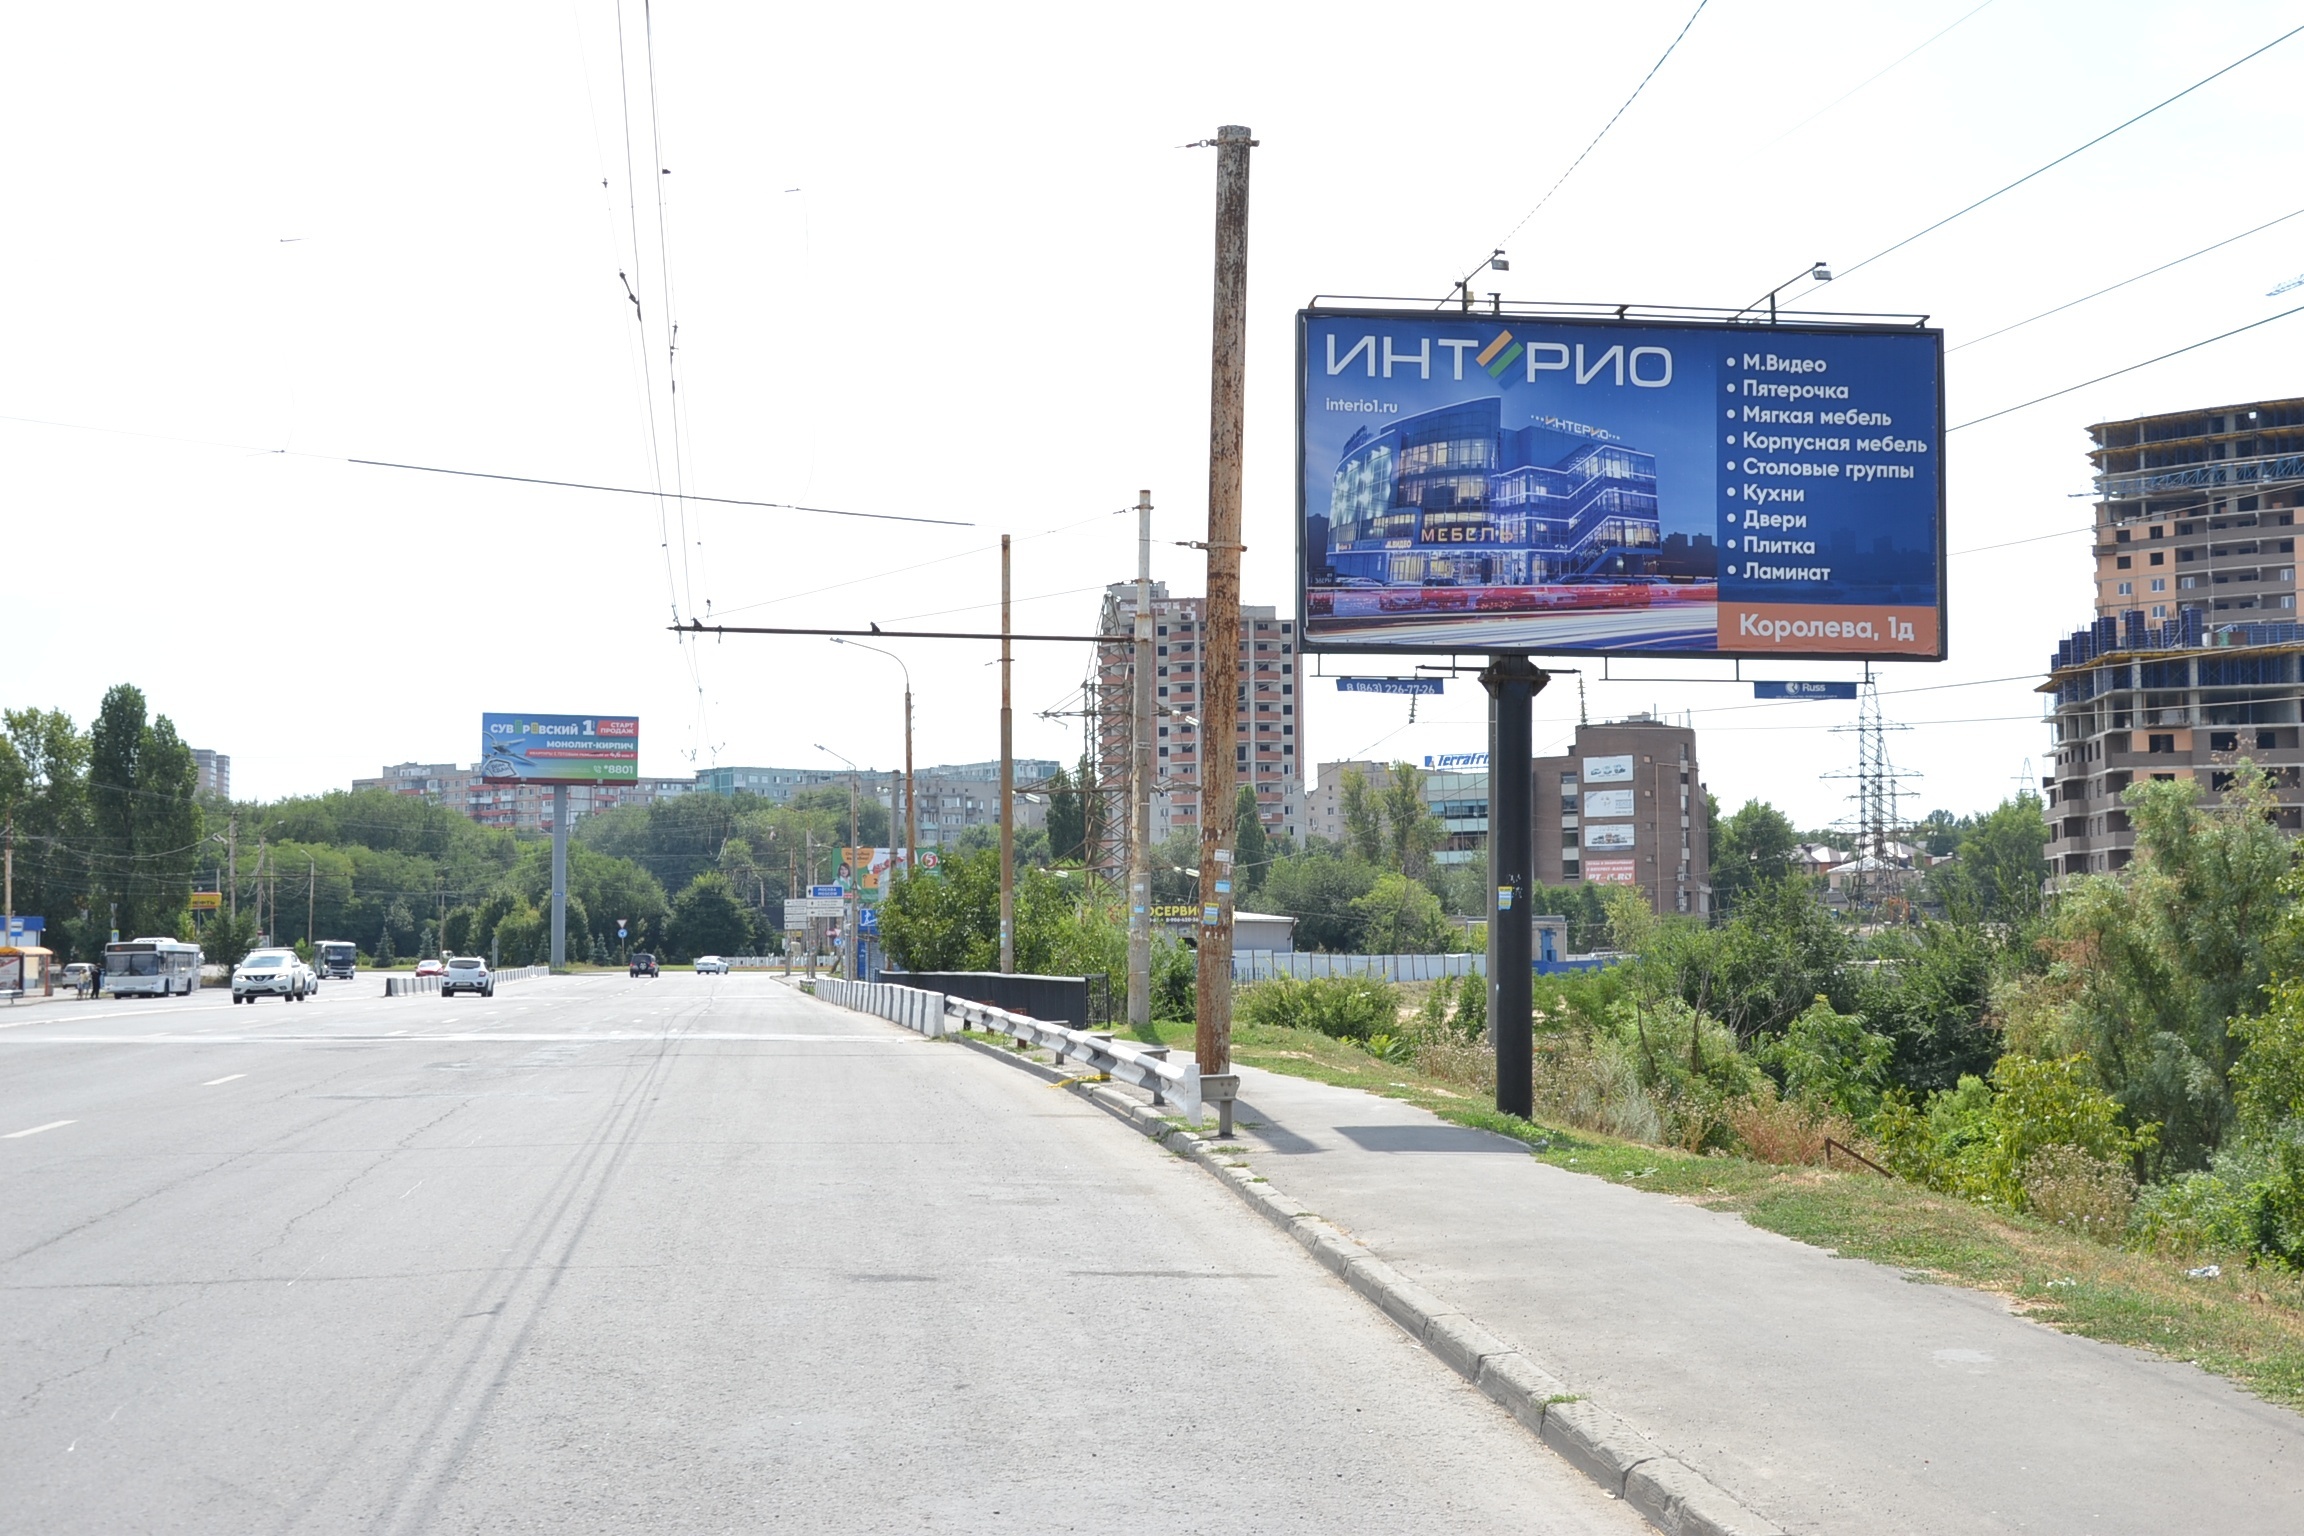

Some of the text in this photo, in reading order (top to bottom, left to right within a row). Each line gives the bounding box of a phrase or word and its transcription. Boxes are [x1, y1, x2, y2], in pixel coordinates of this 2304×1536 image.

[1743, 353, 1827, 373] М.Видео
[1743, 379, 1849, 401] Пятерочка
[1326, 397, 1398, 413] interio1.ru
[1743, 405, 1892, 426] Мягкая мебель
[1743, 431, 1928, 454] Корпусная мебель
[1743, 458, 1915, 482] Столовые группы
[1743, 484, 1805, 505] Кухни
[1743, 510, 1807, 532] Двери
[1743, 536, 1815, 554] Плитка
[1743, 562, 1831, 580] Ламинат
[1740, 613, 1915, 642] Королева, 1д
[1346, 682, 1435, 695] 8 (863) 226-77-26
[1802, 683, 1826, 692] Russ
[546, 740, 634, 750] МОНОЛИТ-КИРПИЧ
[1150, 905, 1199, 917] СЕРВИ
